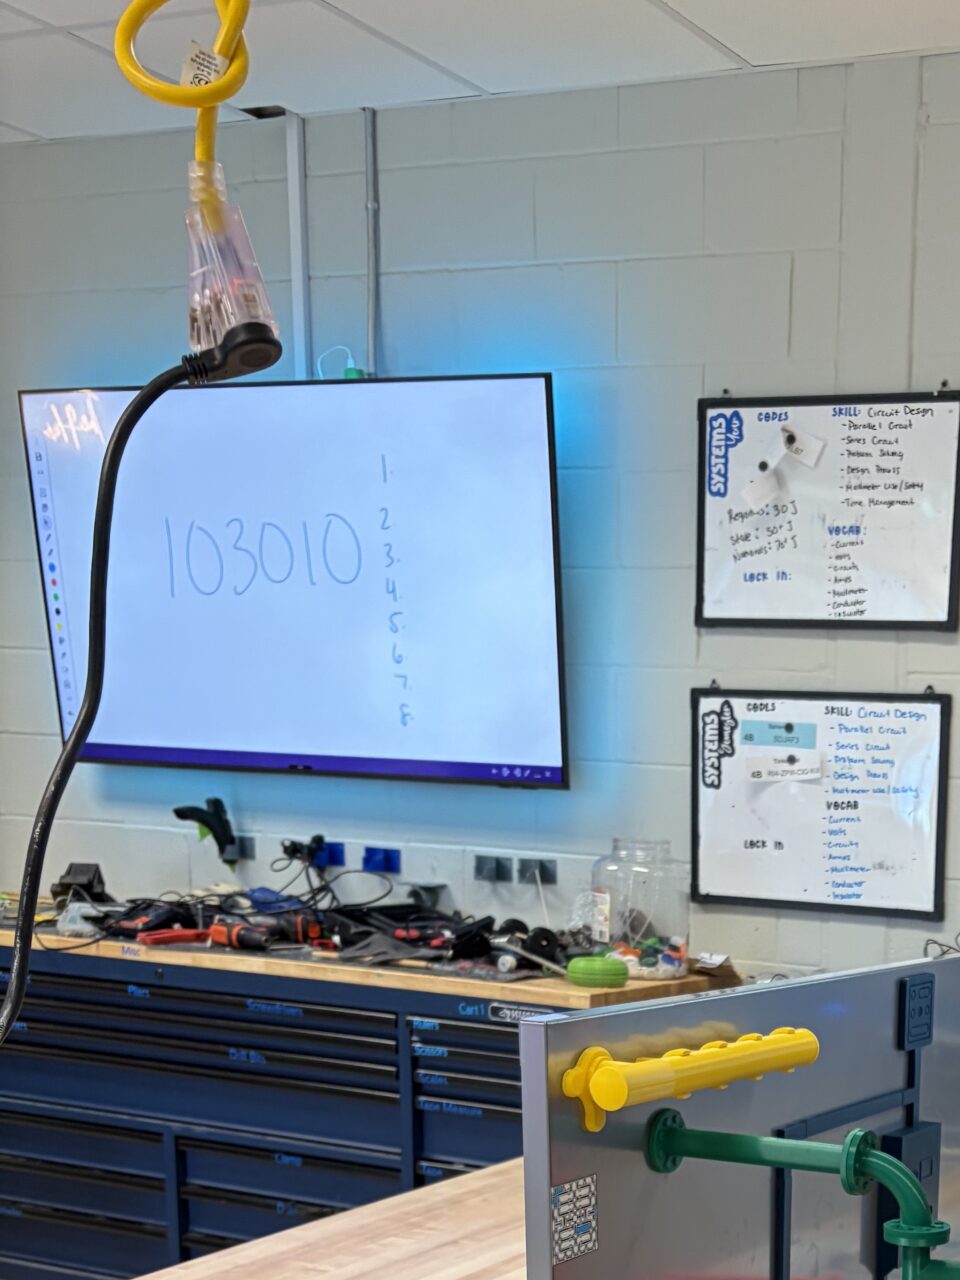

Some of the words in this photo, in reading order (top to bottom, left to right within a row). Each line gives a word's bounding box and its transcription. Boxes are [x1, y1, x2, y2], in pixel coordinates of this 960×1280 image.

[757, 411, 789, 422] CODES
[867, 407, 900, 417] Circuit
[903, 405, 934, 417] Design
[726, 417, 741, 445] Year
[772, 503, 789, 517] 30
[165, 513, 362, 598] 103010
[743, 571, 768, 582] LOCK
[746, 702, 776, 712] CODES
[857, 706, 890, 719] Circuit
[894, 708, 928, 721] Design
[837, 723, 873, 734] Parallel
[878, 726, 907, 735] Circuit
[835, 741, 860, 751] Series
[826, 800, 859, 810] VOCAB
[828, 815, 861, 824] Current
[743, 839, 768, 850] LOCK
